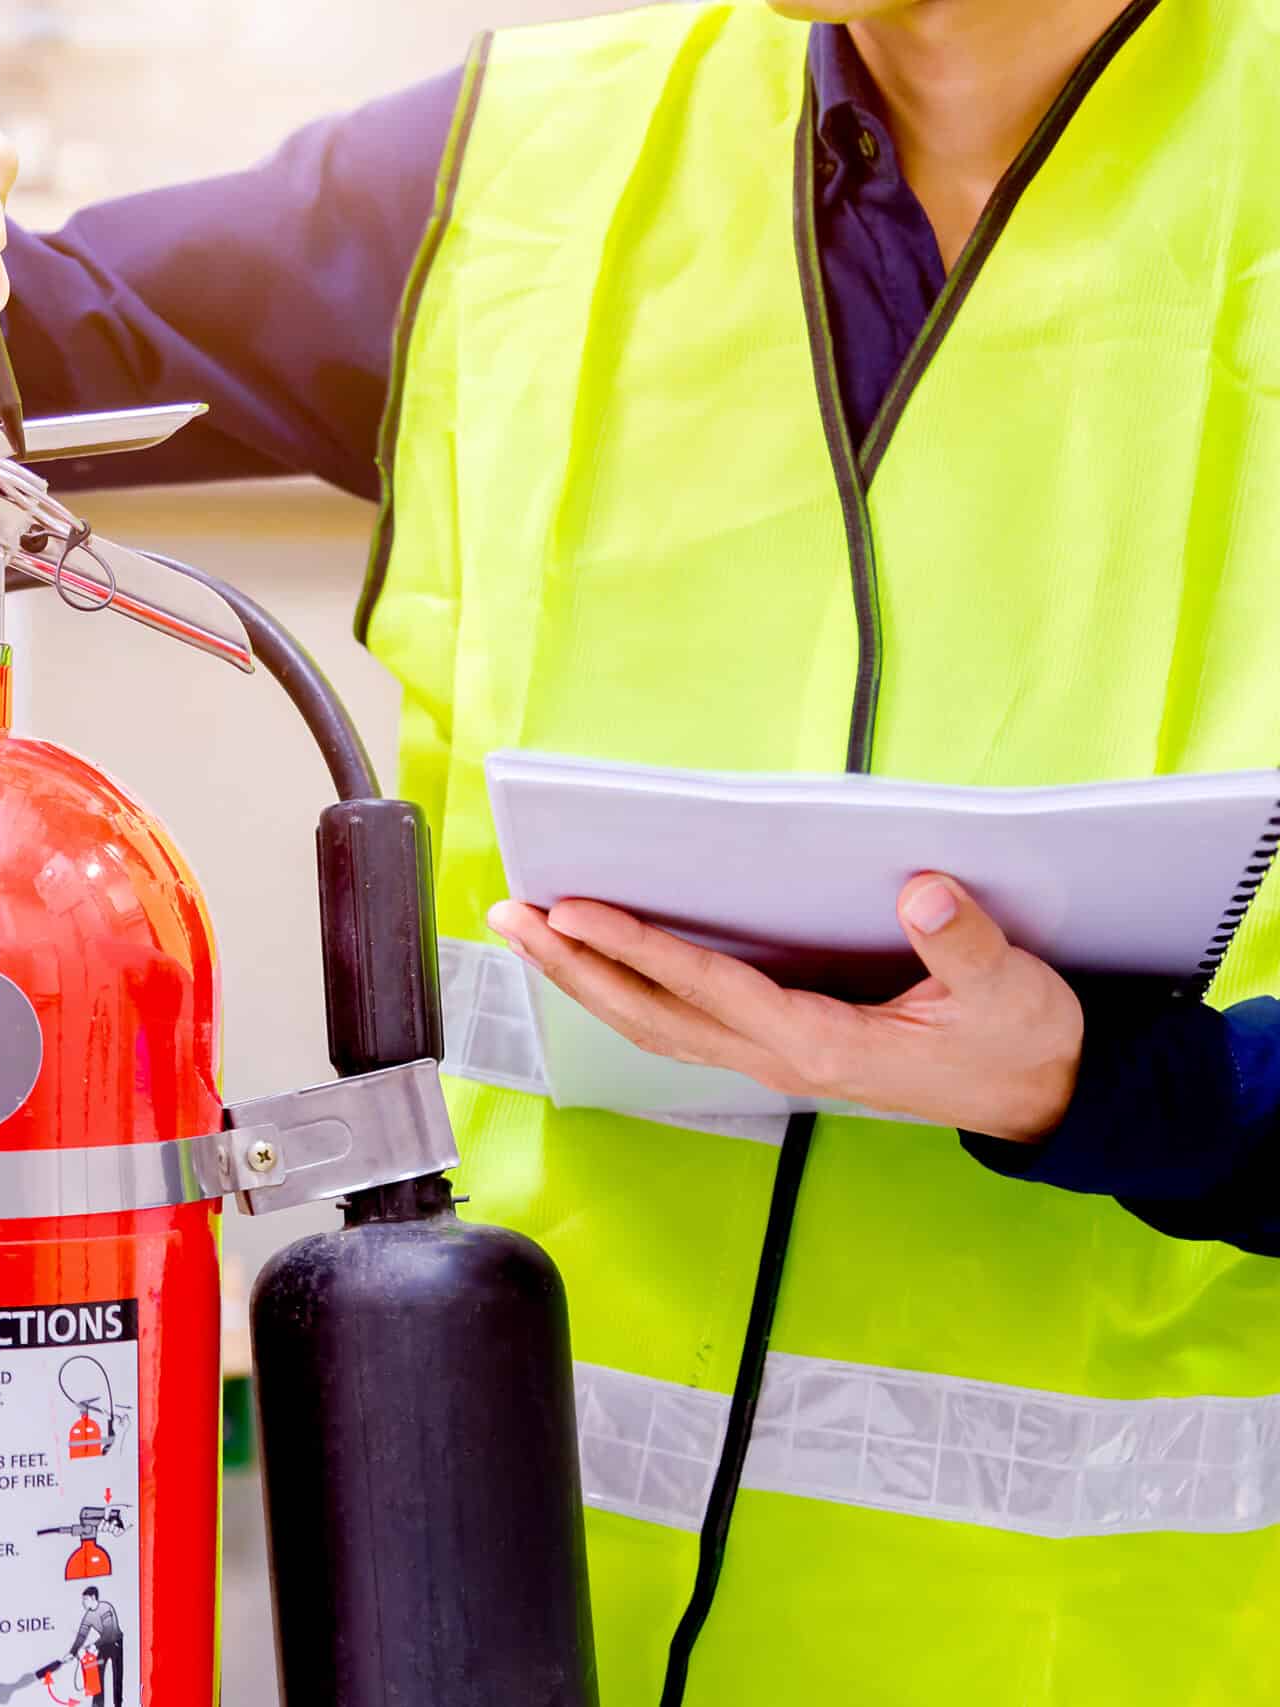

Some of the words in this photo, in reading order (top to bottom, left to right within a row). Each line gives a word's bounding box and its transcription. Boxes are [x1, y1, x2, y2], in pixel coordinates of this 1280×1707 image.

[11, 1453, 48, 1468] FEET.
[24, 1473, 59, 1488] FIRE.
[17, 1617, 55, 1633] SIDE.
